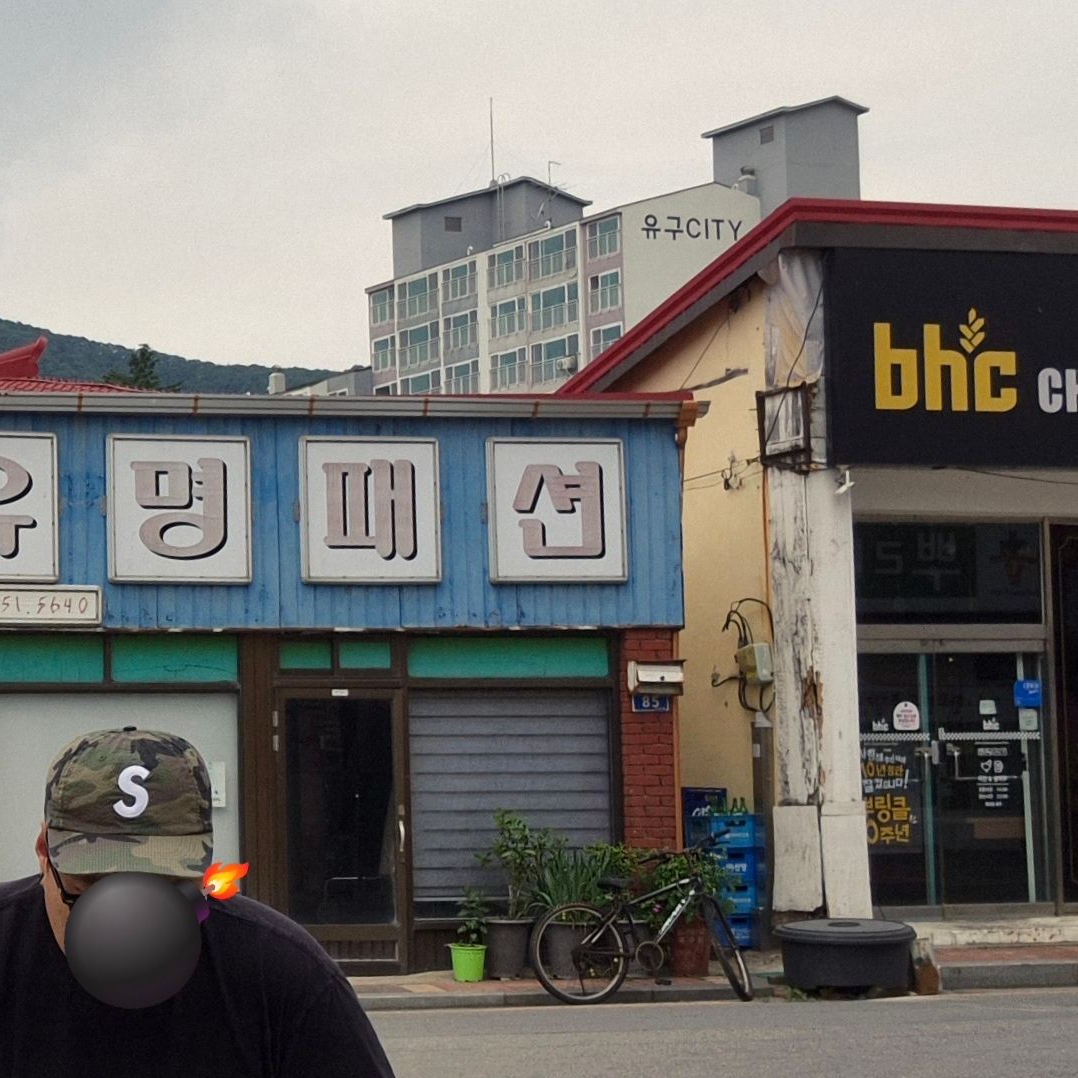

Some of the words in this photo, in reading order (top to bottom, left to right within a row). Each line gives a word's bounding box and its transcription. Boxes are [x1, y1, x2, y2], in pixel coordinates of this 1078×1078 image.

[641, 214, 742, 241] 유구CITY
[873, 322, 1017, 412] bhc
[642, 695, 660, 708] 85
[112, 764, 151, 819] S
[866, 819, 911, 845] 0주년
